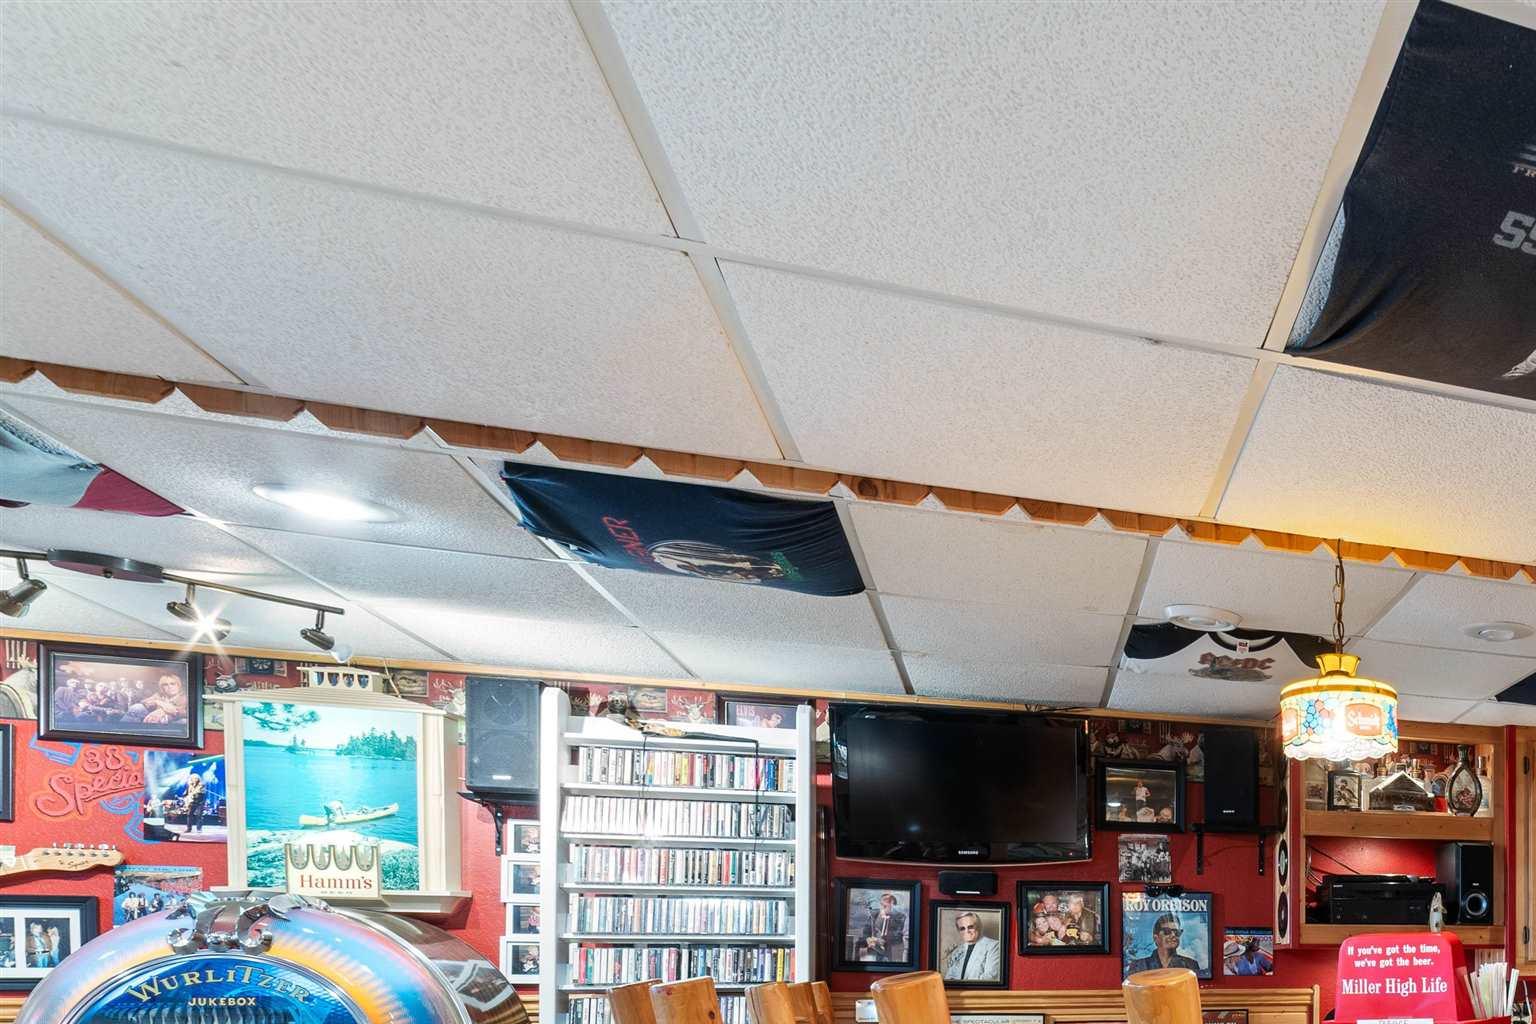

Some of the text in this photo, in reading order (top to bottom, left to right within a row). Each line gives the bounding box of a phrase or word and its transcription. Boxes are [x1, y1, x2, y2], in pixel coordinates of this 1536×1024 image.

[736, 704, 756, 717] ELVIS
[35, 772, 144, 817] Specia
[300, 874, 373, 889] Hamm's
[1124, 899, 1208, 912] ROY ORBISON
[1347, 944, 1441, 957] If you've got the time,
[1354, 957, 1435, 968] we've got the beer.
[126, 965, 311, 1003] WURLITZER
[1342, 977, 1448, 997] Miller High Life
[188, 997, 256, 1007] JUKEBOX
